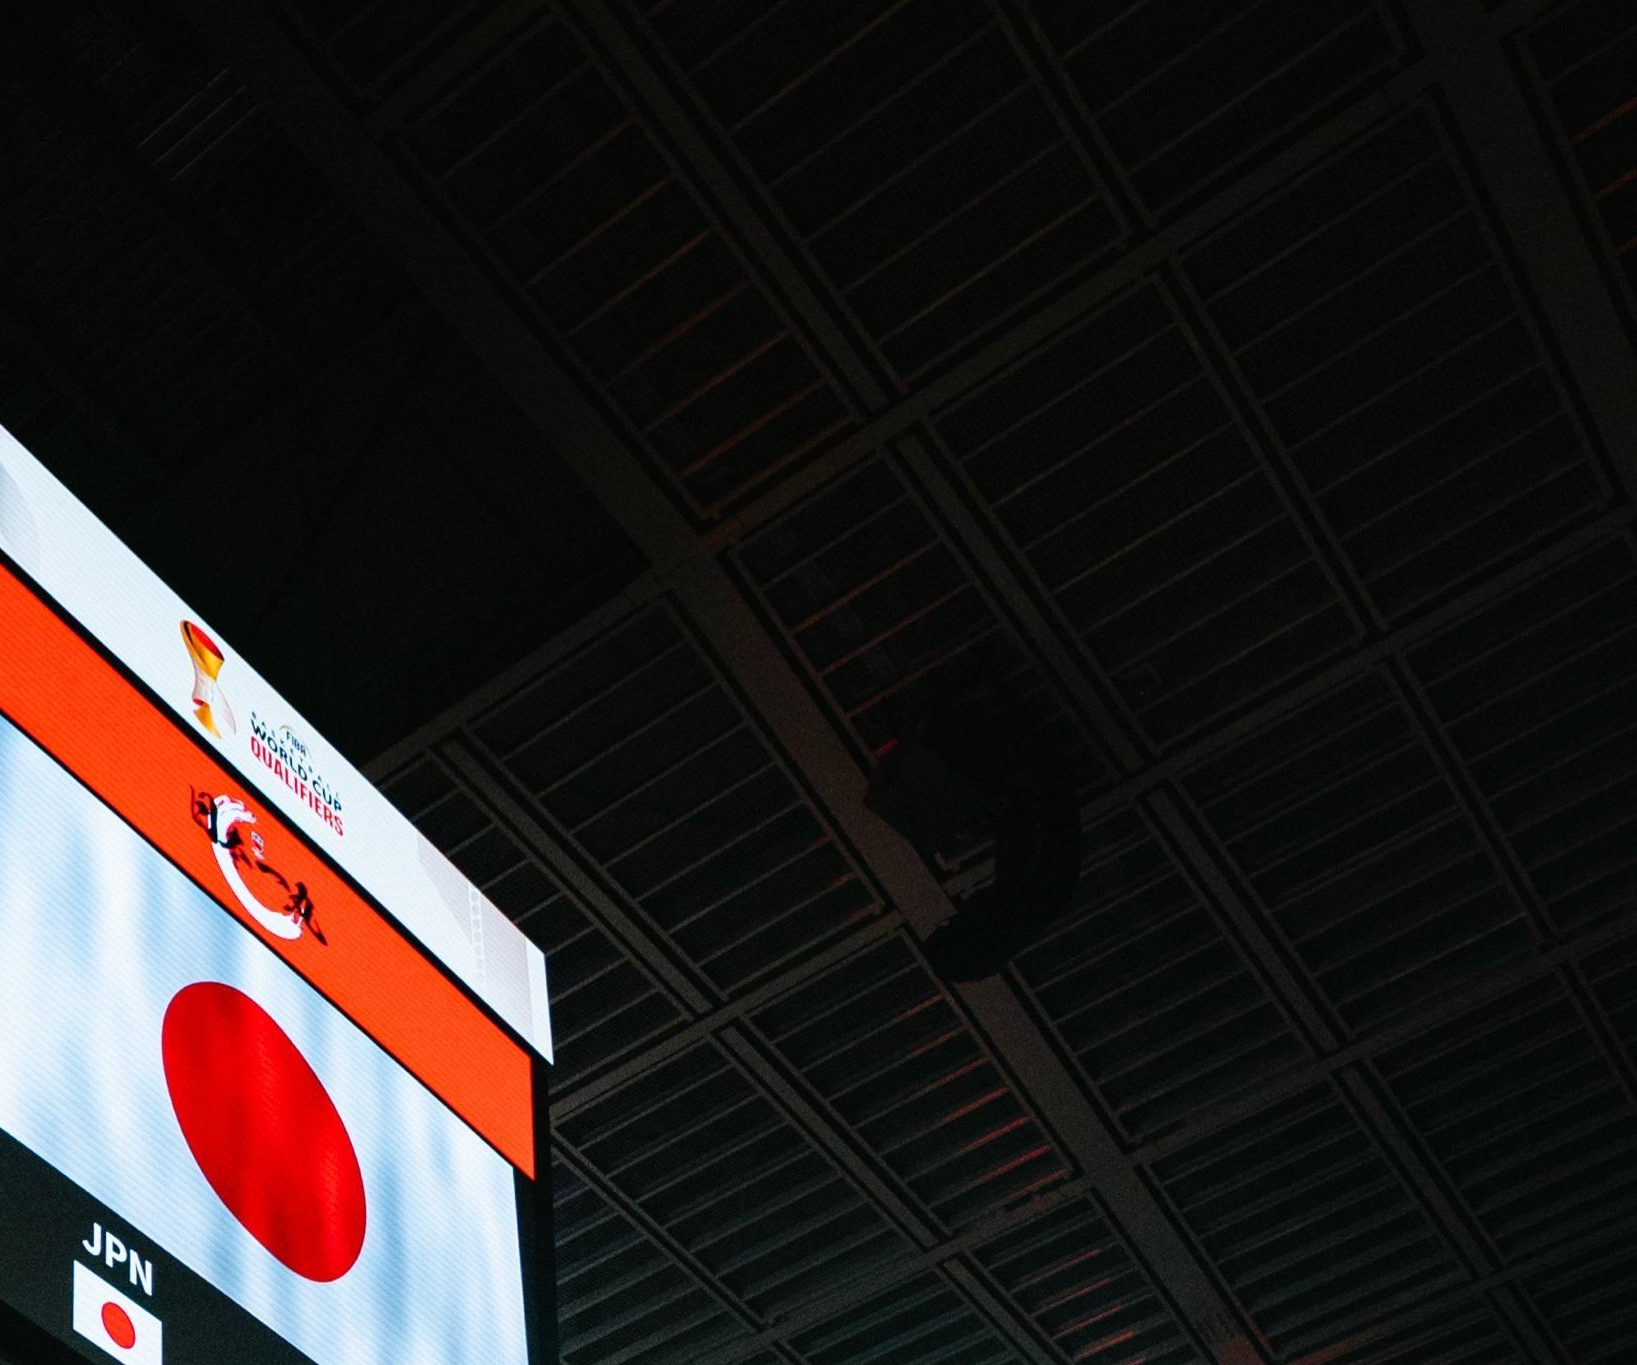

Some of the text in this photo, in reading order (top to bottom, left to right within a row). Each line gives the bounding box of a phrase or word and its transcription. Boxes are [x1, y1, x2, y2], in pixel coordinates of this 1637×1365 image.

[250, 718, 308, 781] WORLD
[312, 780, 342, 812] CUP
[250, 735, 344, 837] QUALIFIERS
[82, 1222, 153, 1297] JPN
